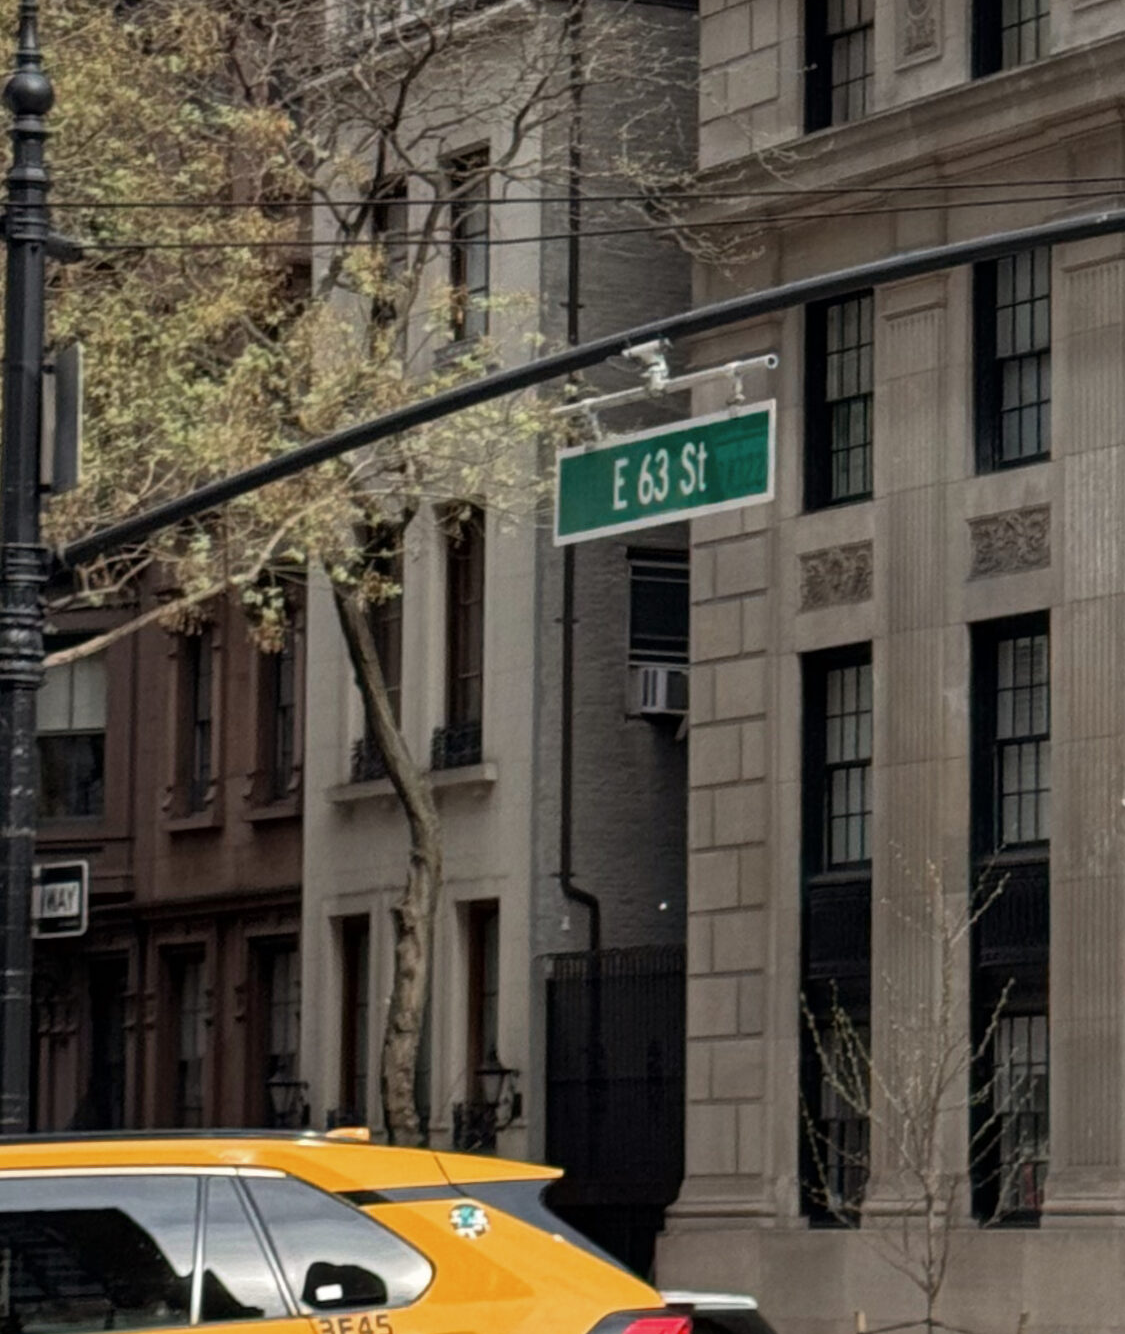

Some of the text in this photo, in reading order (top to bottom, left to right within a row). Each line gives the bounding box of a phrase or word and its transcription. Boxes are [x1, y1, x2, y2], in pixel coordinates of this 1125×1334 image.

[613, 441, 708, 510] E 63 St
